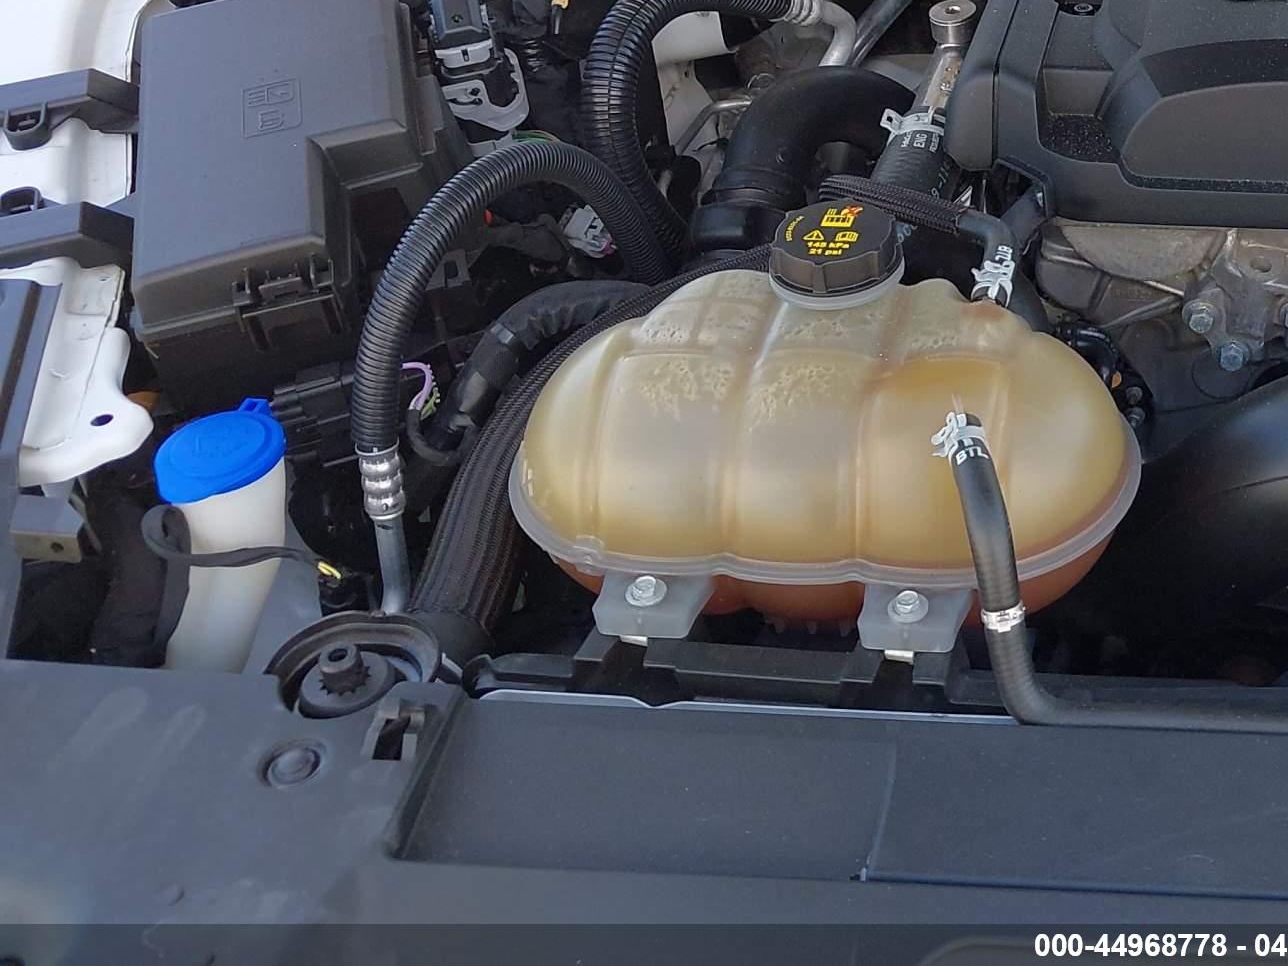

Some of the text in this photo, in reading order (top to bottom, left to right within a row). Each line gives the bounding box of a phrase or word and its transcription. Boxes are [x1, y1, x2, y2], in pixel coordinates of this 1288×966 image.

[913, 133, 928, 148] ENG
[828, 241, 850, 249] kPa
[824, 248, 843, 256] psi
[955, 446, 990, 466] BTL
